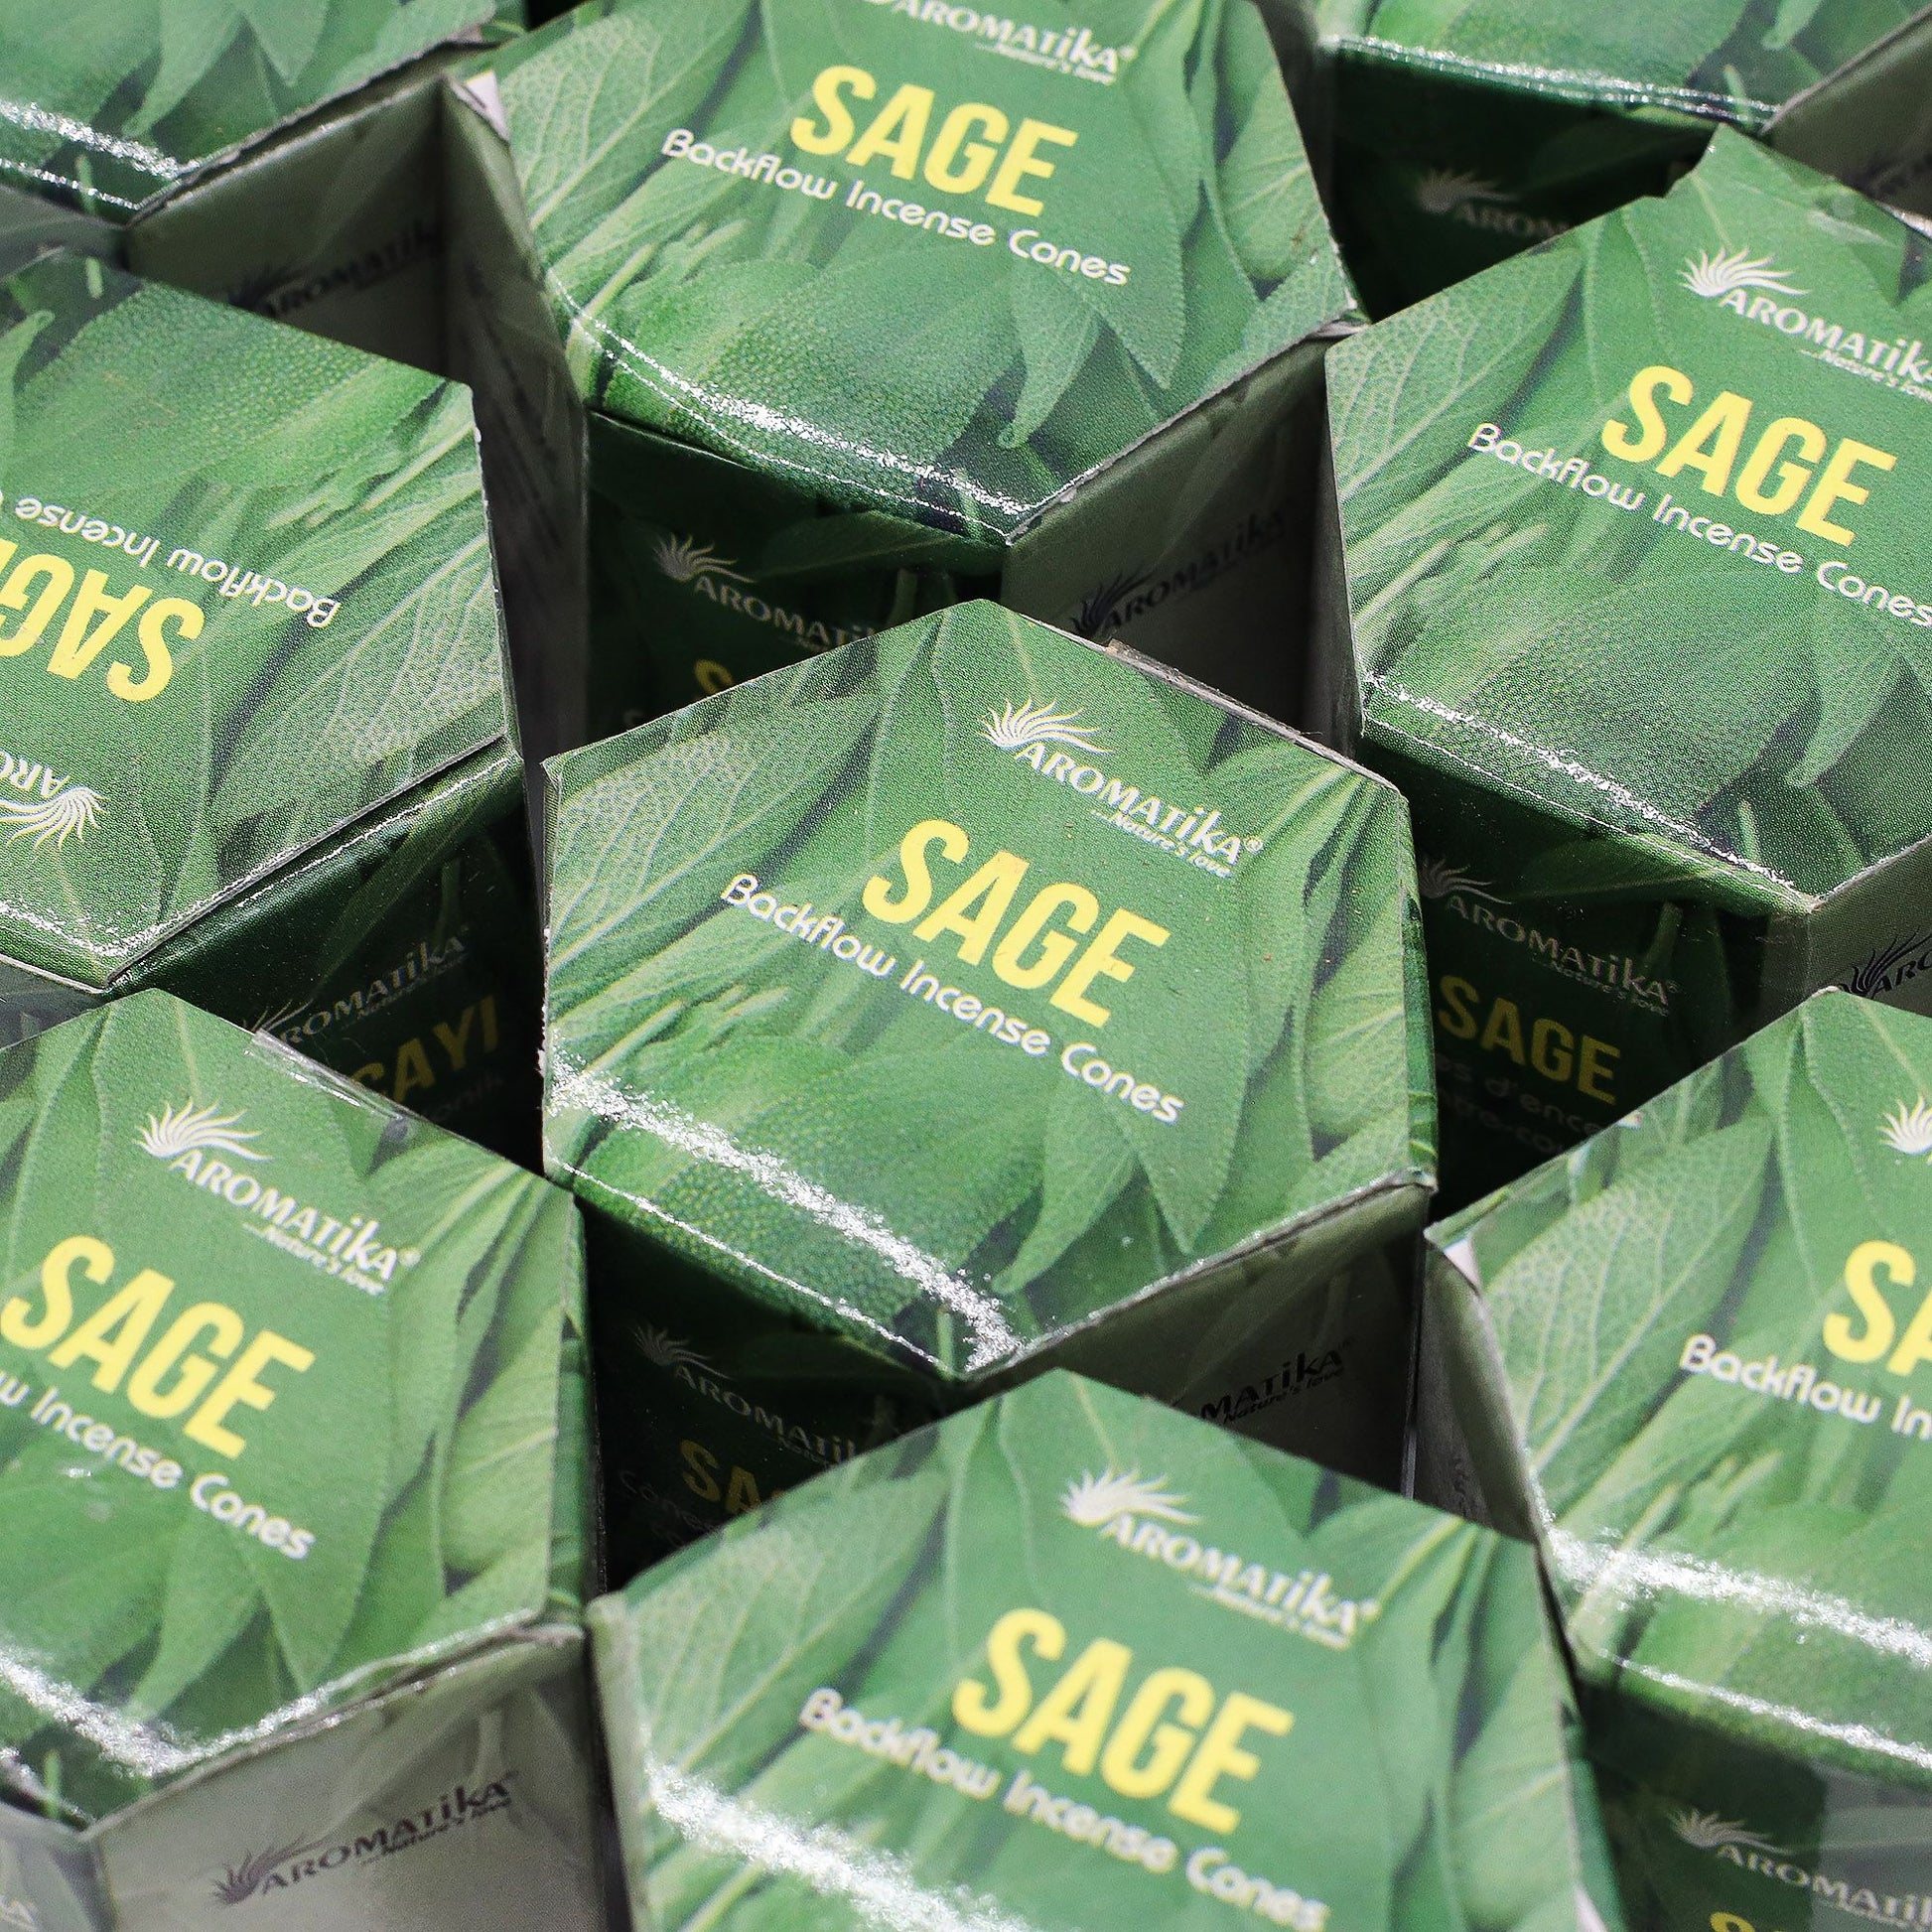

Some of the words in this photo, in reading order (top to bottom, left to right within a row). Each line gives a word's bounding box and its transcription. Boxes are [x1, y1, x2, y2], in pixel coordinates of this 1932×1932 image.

[662, 128, 838, 200] Backflow
[846, 180, 996, 246] Incense
[1007, 228, 1131, 286] Cones
[790, 66, 1078, 216] SAGE
[15, 495, 161, 569] Incense
[1467, 422, 1646, 511] Backflow
[1651, 493, 1805, 574] Incense
[1817, 560, 1932, 627] Cones
[1601, 365, 1897, 547] SAGE
[0, 536, 206, 701] SAG
[165, 546, 343, 629] Backflow
[721, 873, 897, 979] Backflow
[899, 958, 1051, 1058] Incense
[1059, 1041, 1185, 1124] Cones
[862, 819, 1171, 1029] SAGE
[1438, 974, 1622, 1106] SAGE
[0, 1235, 316, 1459] SAGE
[1680, 1332, 1882, 1425] Backflow
[30, 1386, 184, 1489] Incense
[190, 1472, 317, 1559] Cones
[679, 1439, 787, 1516] SA
[799, 1688, 1001, 1801] Backflow
[1003, 1769, 1177, 1874] Incense
[951, 1607, 1294, 1834] SAGE
